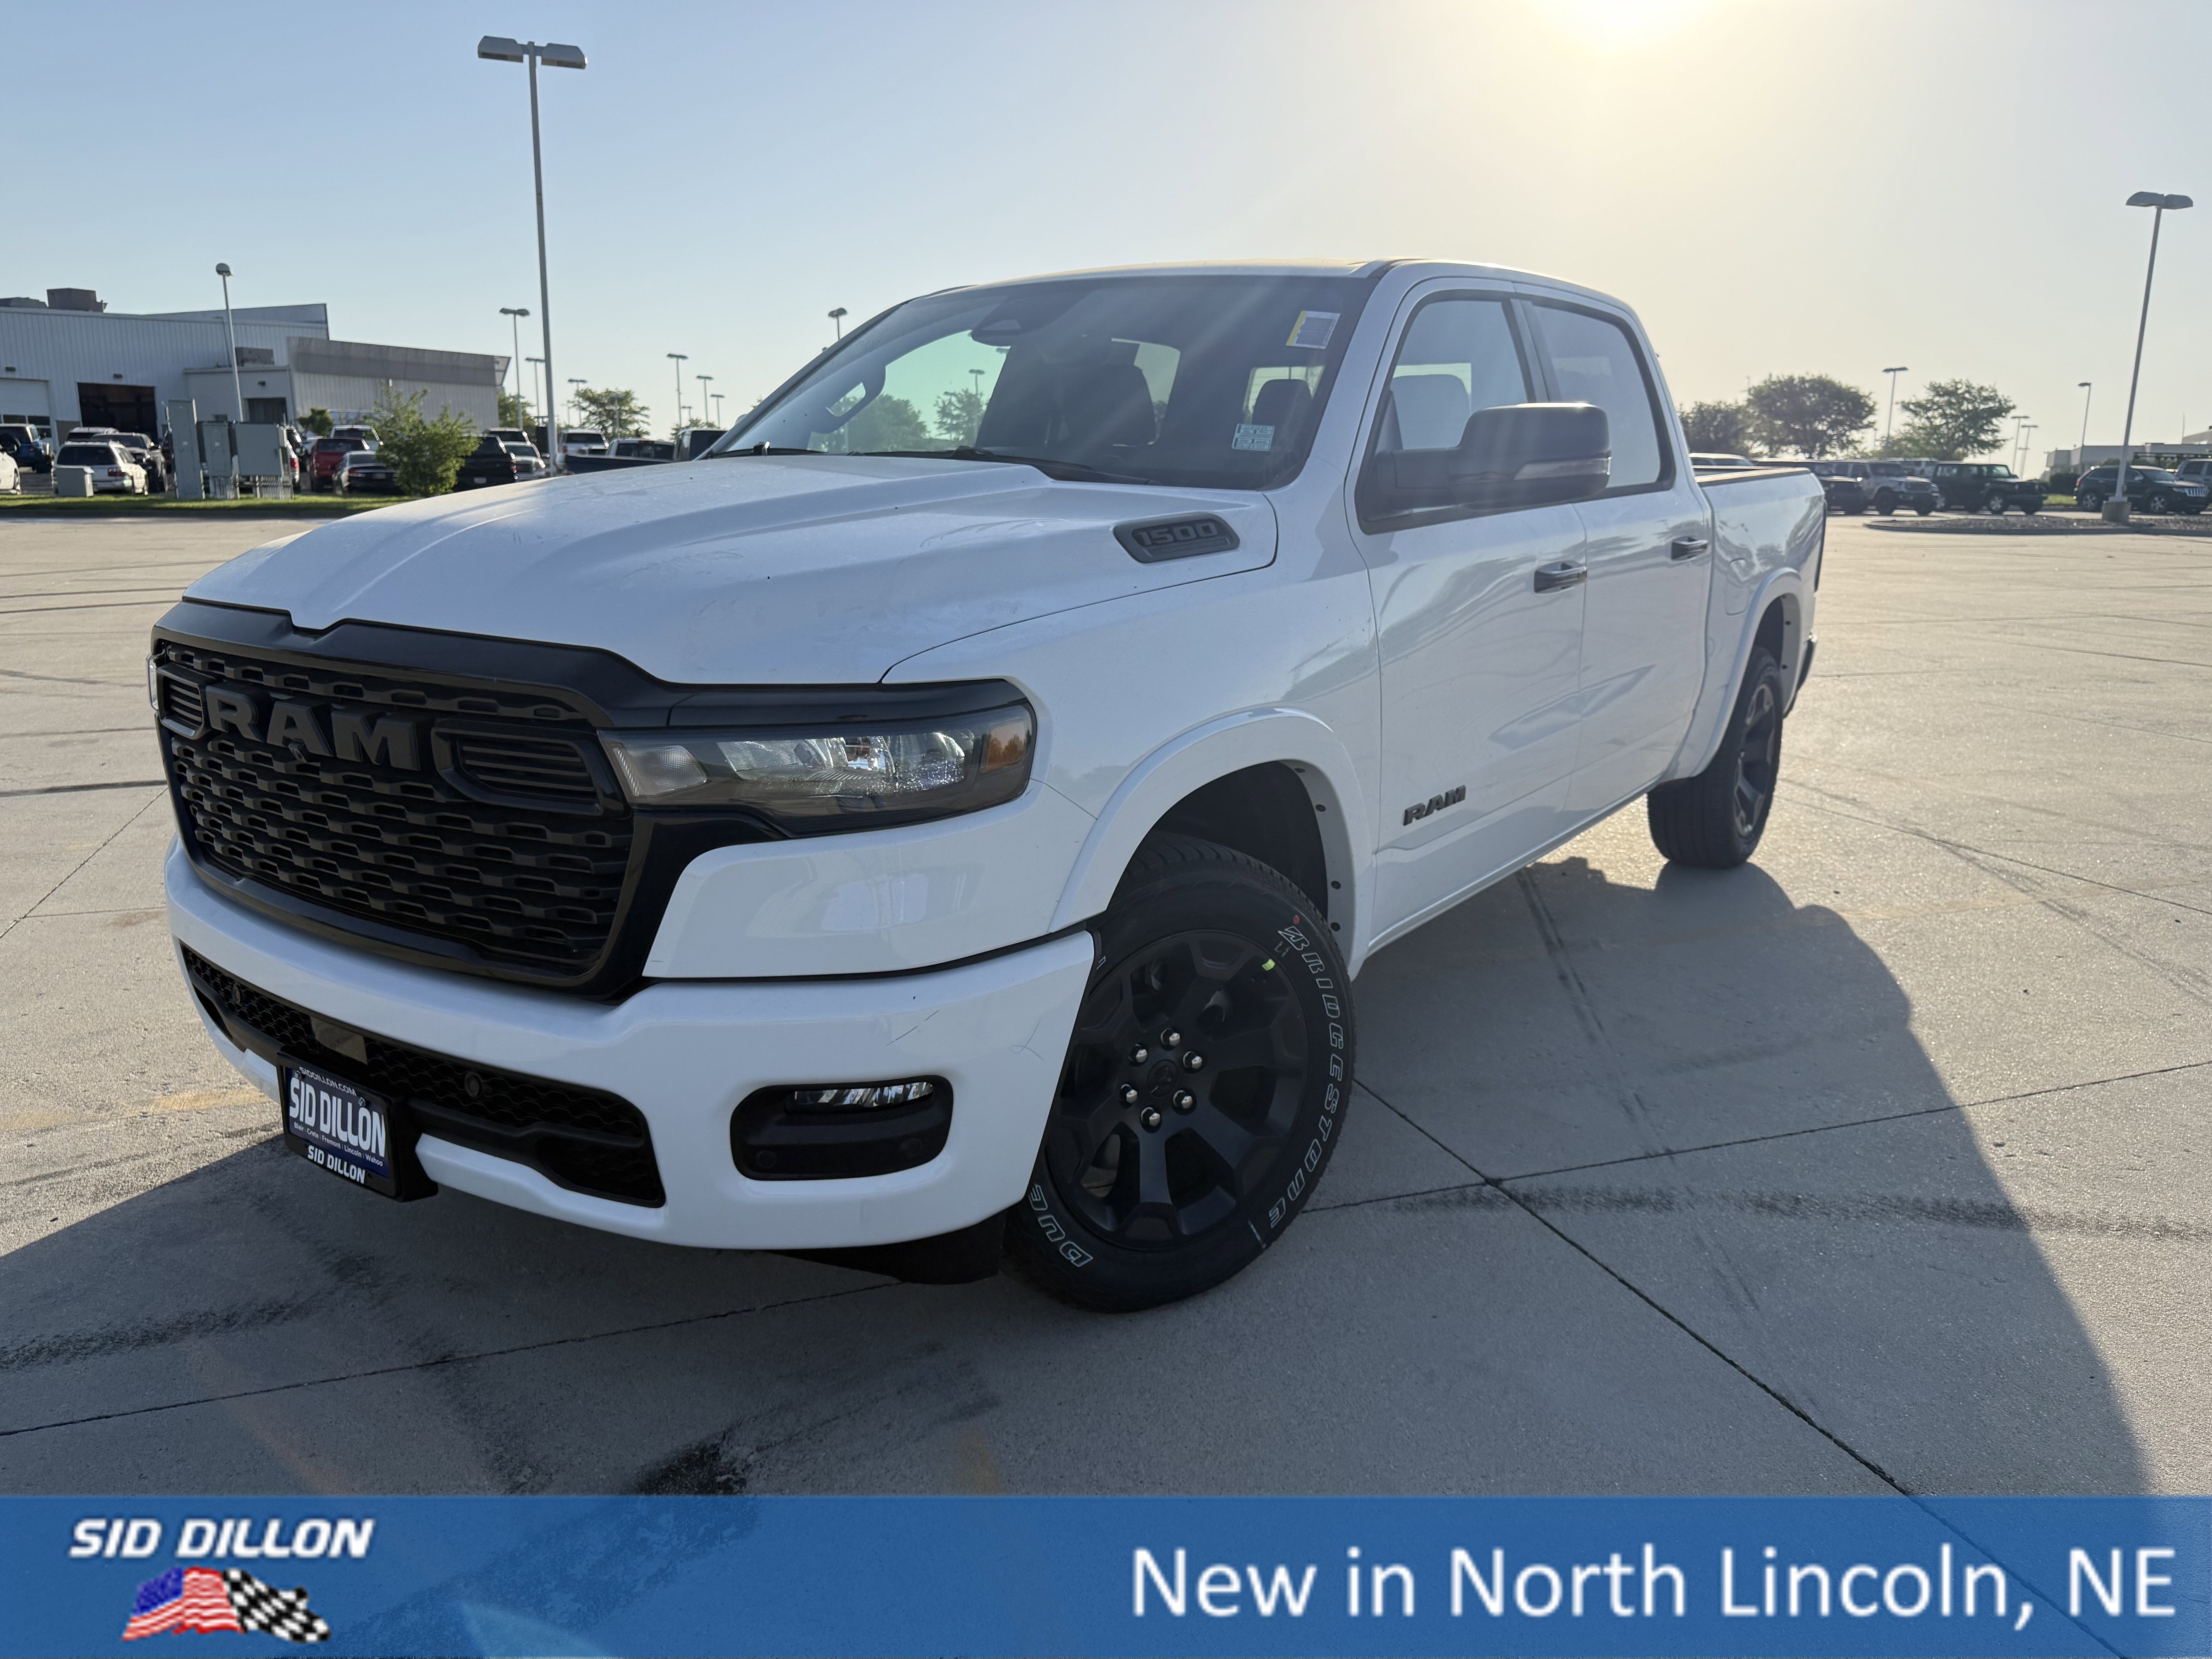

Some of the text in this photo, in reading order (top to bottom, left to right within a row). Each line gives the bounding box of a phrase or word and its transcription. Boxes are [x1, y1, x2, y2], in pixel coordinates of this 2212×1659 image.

[1137, 523, 1218, 545] 1500
[206, 685, 420, 771] RAM
[1403, 785, 1466, 826] RAM
[299, 1066, 357, 1096] SIDDILLON.COM
[1269, 926, 1344, 1228] BRIDGESTONE
[290, 1077, 386, 1157] SID DILLON
[294, 1122, 383, 1166] Blair Crete Fremont Lincoln Wahoo
[307, 1145, 366, 1184] SID DILLON
